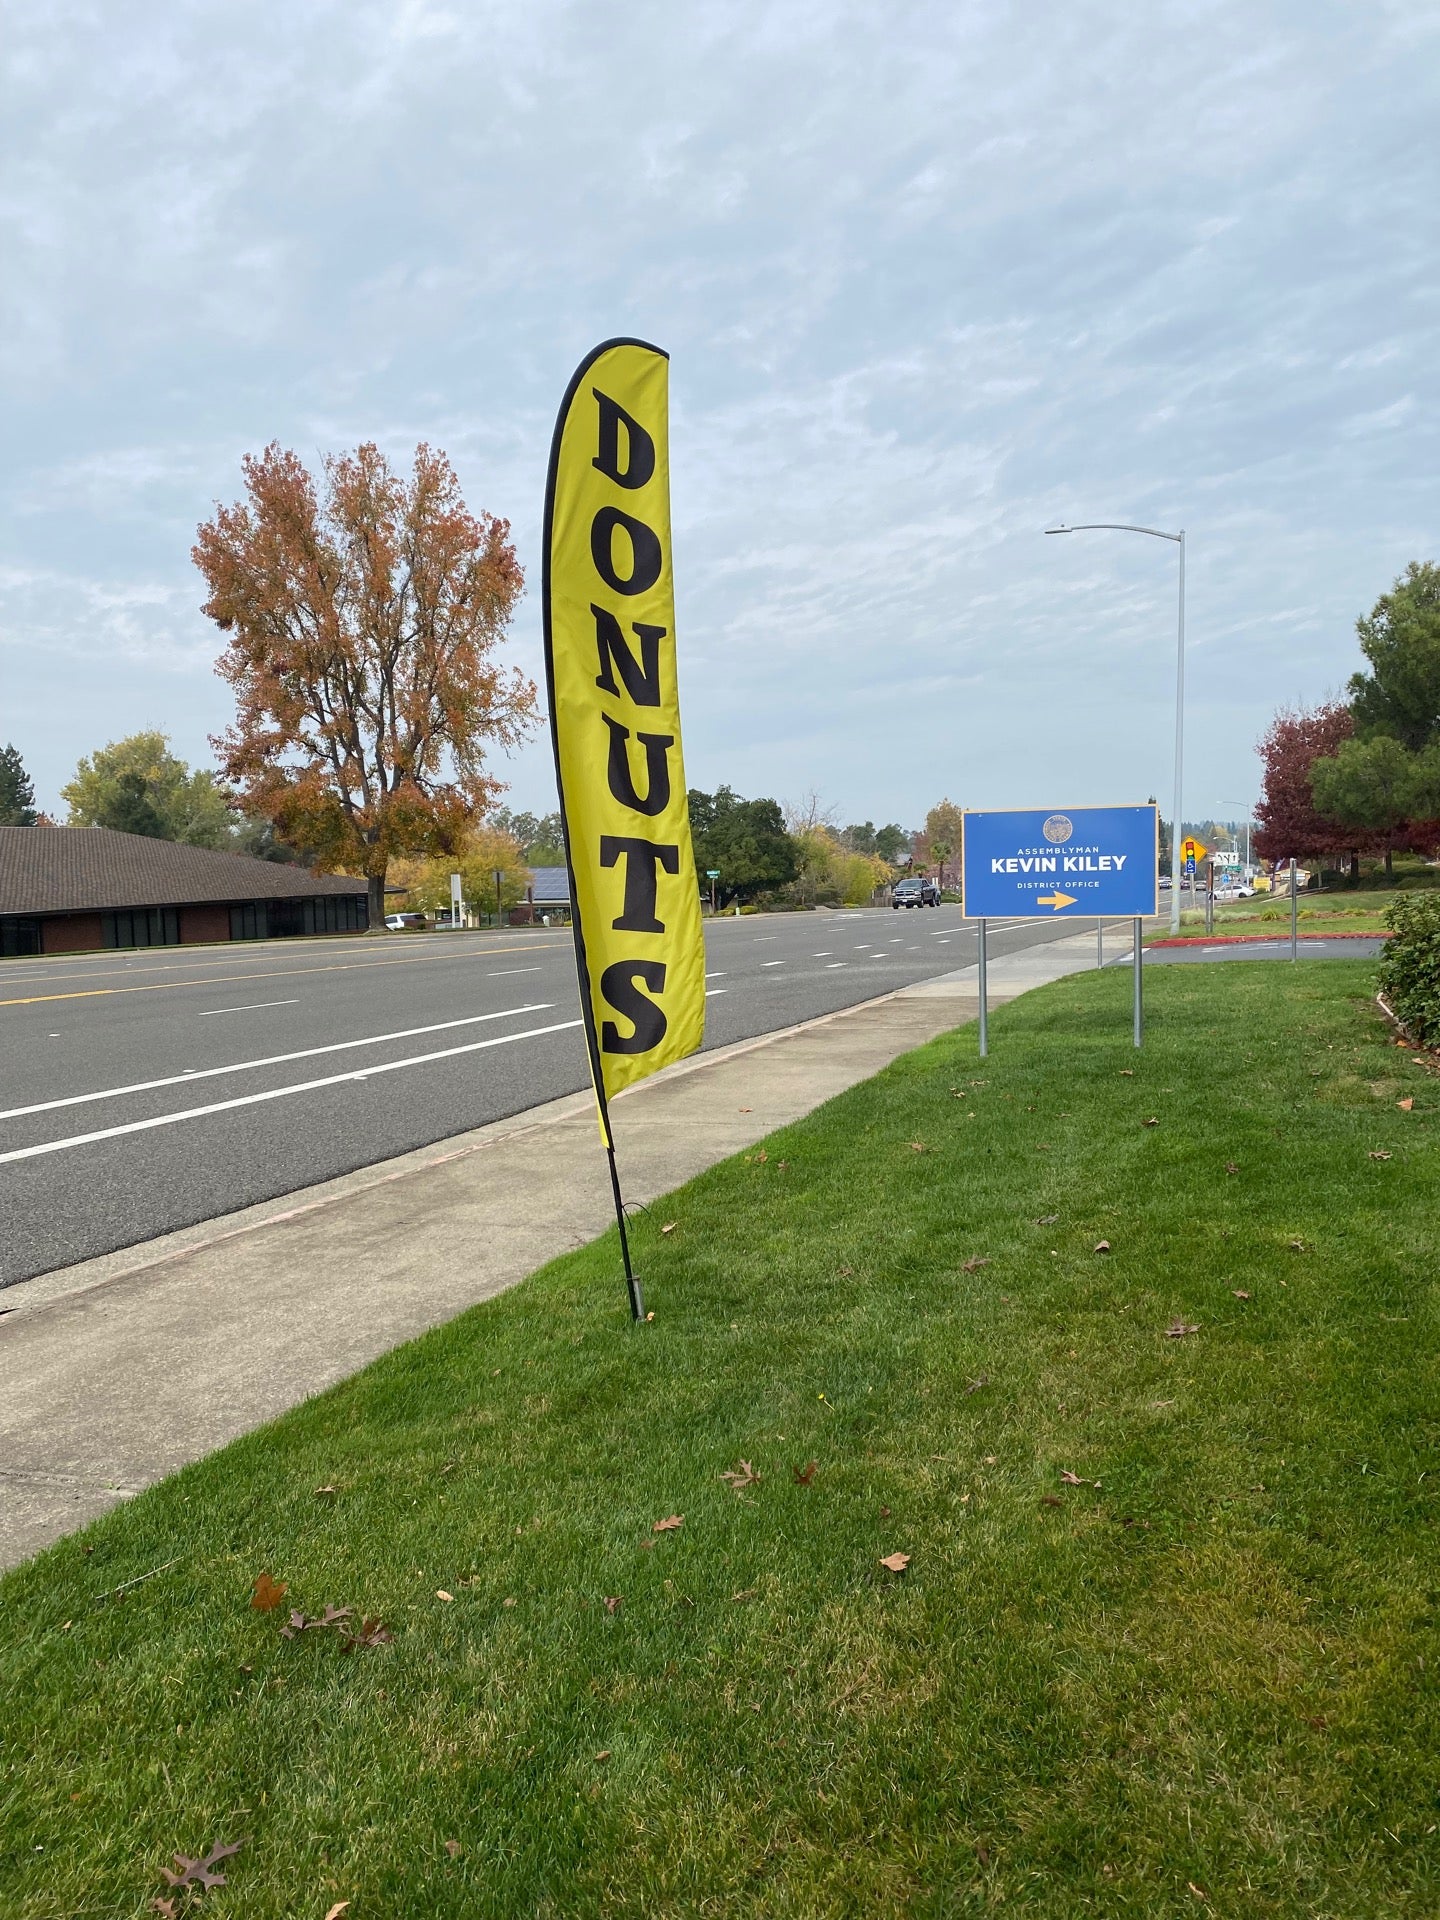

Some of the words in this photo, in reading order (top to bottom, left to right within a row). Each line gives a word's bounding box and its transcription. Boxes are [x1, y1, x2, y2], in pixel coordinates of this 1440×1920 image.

[590, 386, 679, 1056] DONUTS
[1017, 846, 1099, 856] ASSEMBLYMAN
[991, 857, 1056, 873] KEVIN
[1063, 855, 1127, 872] KILEY
[1017, 881, 1061, 889] DISTRICT
